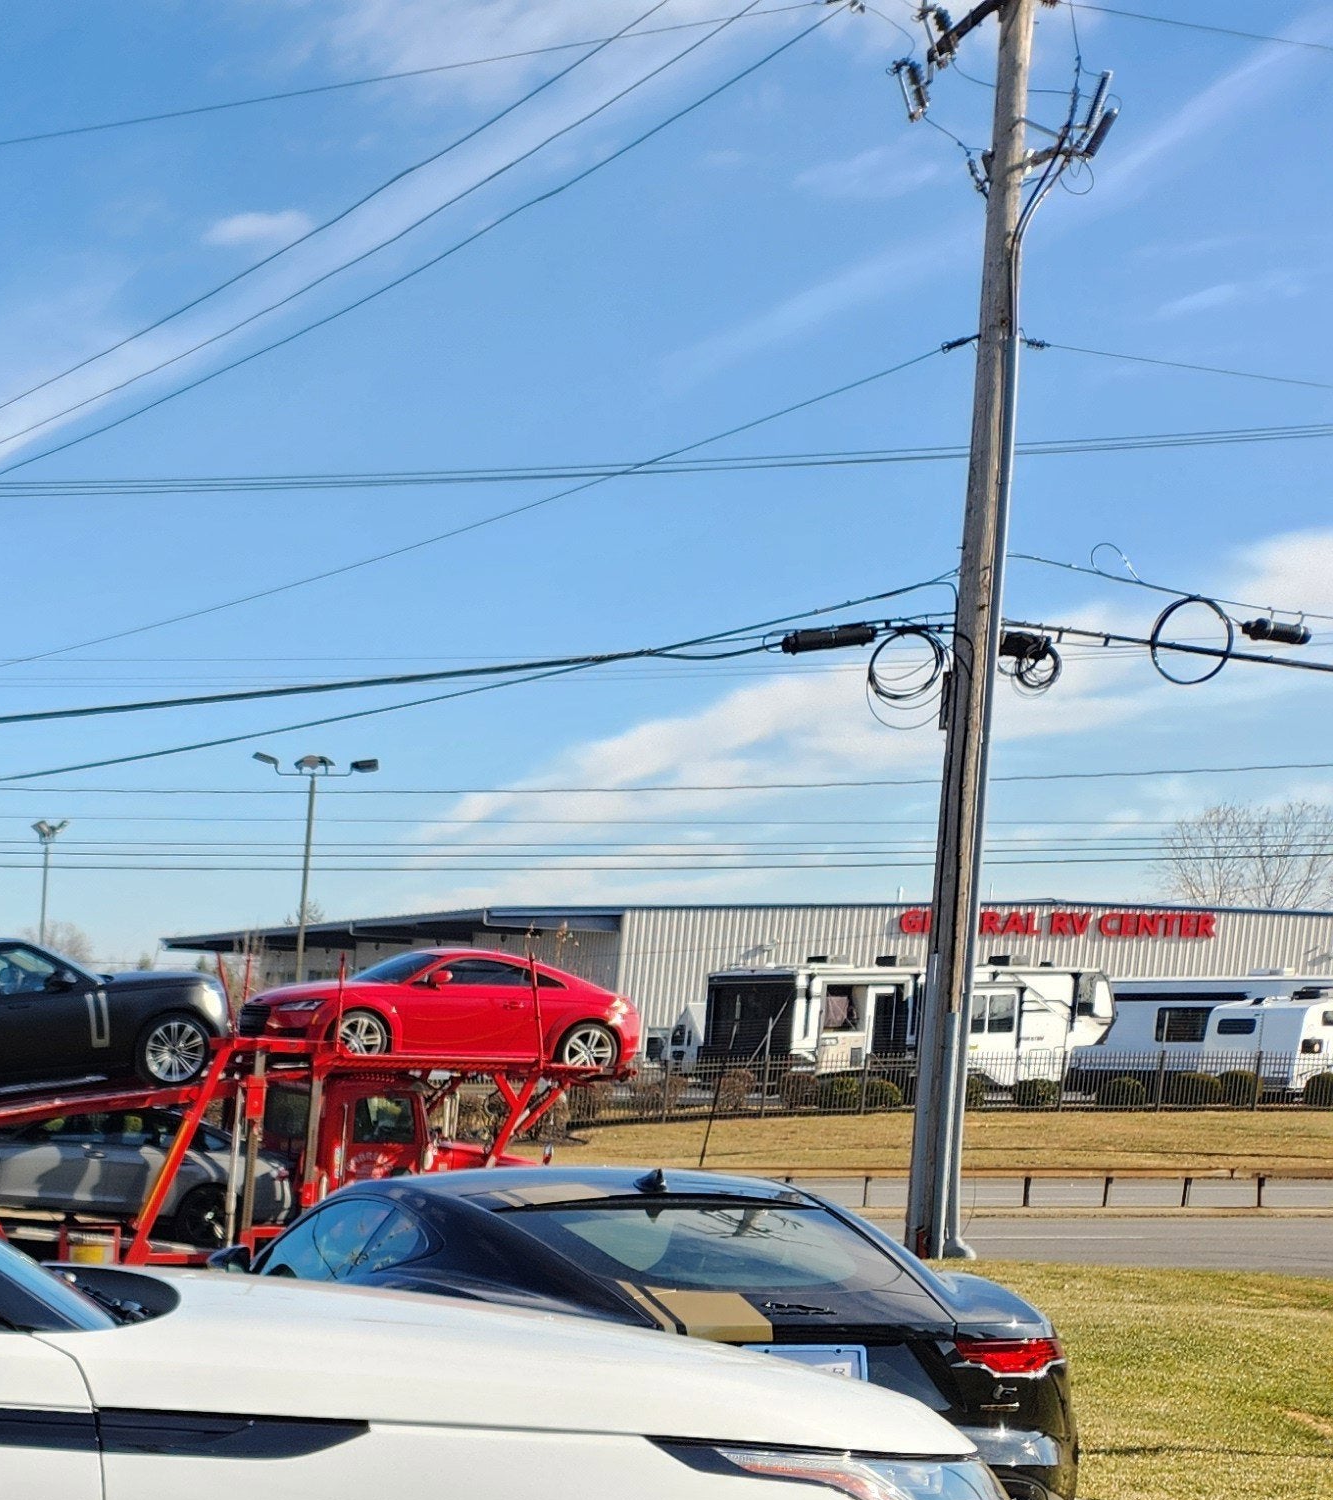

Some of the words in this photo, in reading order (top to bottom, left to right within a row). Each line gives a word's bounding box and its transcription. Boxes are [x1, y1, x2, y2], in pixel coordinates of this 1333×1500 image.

[900, 909, 1041, 936] GRAL
[1050, 911, 1091, 936] RV
[1099, 913, 1216, 938] CENTER
